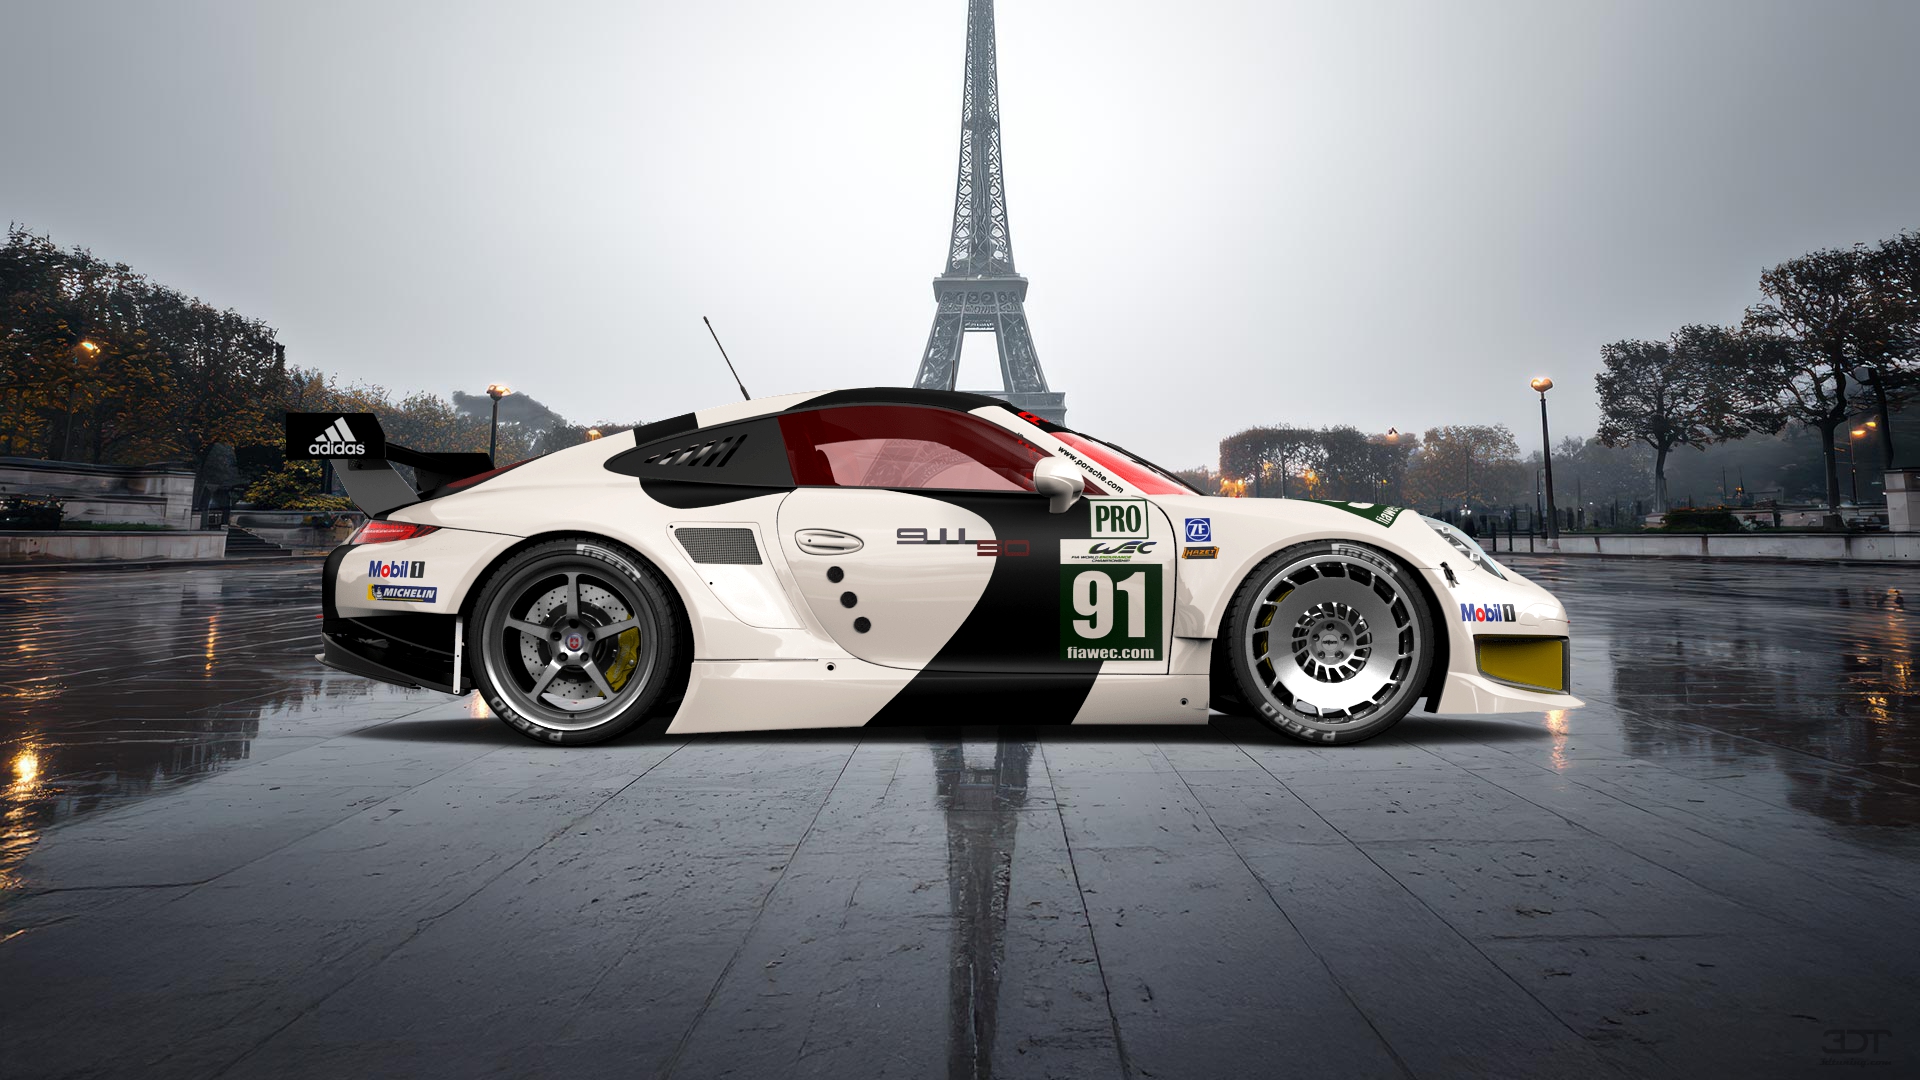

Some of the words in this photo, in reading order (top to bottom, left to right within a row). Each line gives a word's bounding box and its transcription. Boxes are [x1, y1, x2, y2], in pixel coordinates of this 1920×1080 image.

[308, 441, 366, 455] adidas
[1057, 446, 1124, 494] www.porsche.com
[1095, 505, 1142, 533] PRO
[896, 528, 966, 545] 911
[1188, 523, 1208, 537] ZF
[976, 539, 1030, 557] 50
[1088, 540, 1158, 554] WEC
[1186, 549, 1215, 557] HAZET
[368, 560, 409, 578] Mobil
[383, 587, 436, 599] MICHELIN
[1072, 571, 1146, 639] 91
[1460, 603, 1503, 622] Mobil
[1067, 646, 1155, 659] fiawec.com
[490, 696, 546, 738] ZERO
[1259, 702, 1320, 739] ZERO
